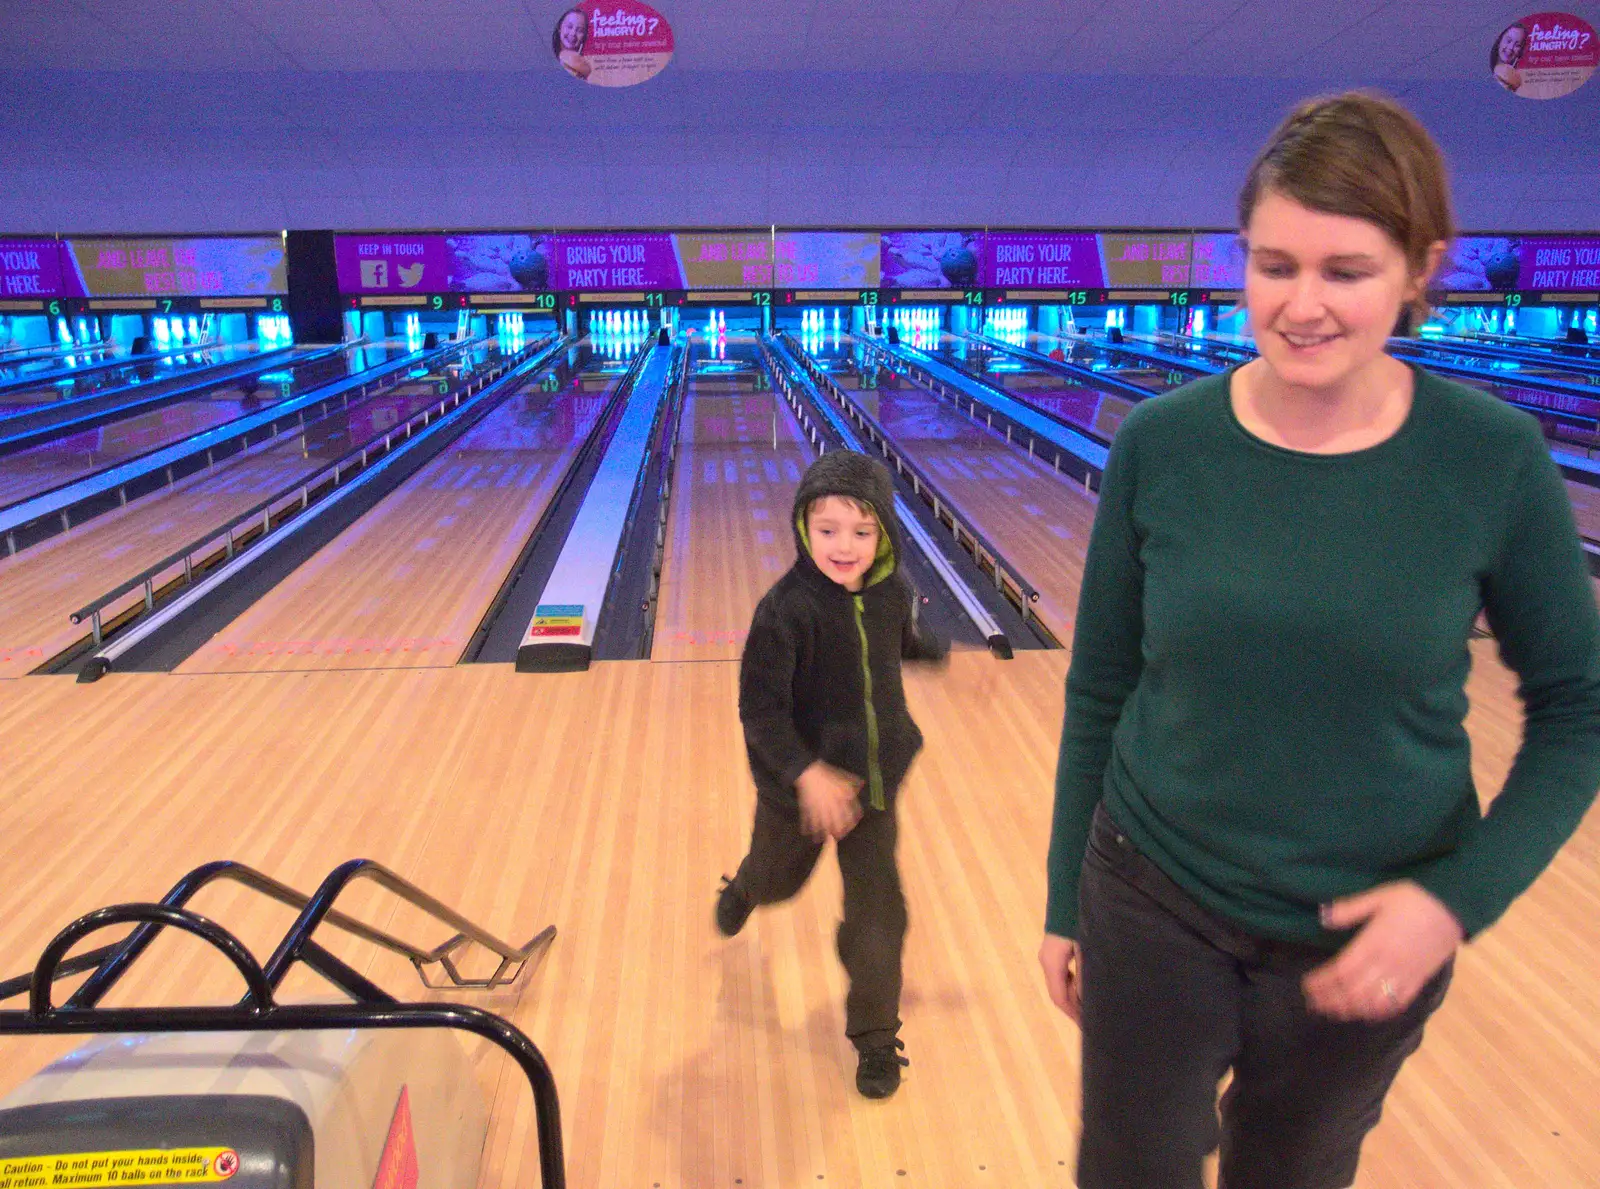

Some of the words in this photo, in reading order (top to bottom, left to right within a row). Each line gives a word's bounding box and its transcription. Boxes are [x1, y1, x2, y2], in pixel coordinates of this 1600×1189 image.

[591, 8, 646, 36] feeling
[1528, 24, 1580, 50] feeling
[358, 244, 380, 256] KEEP
[382, 244, 392, 256] IN
[394, 244, 424, 256] TOUCH
[567, 246, 607, 264] BRING
[608, 245, 644, 263] YOUR
[731, 242, 768, 260] LEAVE
[996, 244, 1034, 262] BRING
[1038, 244, 1071, 262] YOUR
[1152, 242, 1188, 260] LEAVE
[1536, 248, 1571, 266] BRING
[0, 251, 40, 270] YOUR
[568, 268, 608, 287] PARTY
[743, 265, 773, 284] REST
[778, 264, 794, 282] TO
[996, 267, 1034, 284] PARTY
[1162, 264, 1190, 282] REST
[1195, 264, 1209, 281] TO
[1532, 270, 1570, 288] PARTY
[272, 298, 282, 312] 8
[432, 296, 442, 310] 9
[536, 294, 555, 308] 10
[646, 294, 664, 308] 11
[752, 292, 771, 306] 12
[860, 292, 878, 304] 13
[964, 292, 982, 304] 14
[1069, 292, 1086, 304] 15
[1170, 292, 1188, 304] 16
[1505, 294, 1522, 306] 19
[50, 300, 60, 315] 6
[162, 300, 172, 314] 7
[4, 1162, 43, 1175] Caution
[55, 1160, 68, 1170] Do
[72, 1159, 88, 1169] not
[91, 1158, 109, 1170] put
[112, 1157, 134, 1169] your
[138, 1156, 168, 1166] hands
[172, 1152, 202, 1164] inside
[52, 1174, 102, 1184] Maximum
[108, 1170, 118, 1181] 10
[122, 1169, 146, 1180] balls
[149, 1170, 162, 1179] on
[166, 1168, 182, 1178] the
[186, 1166, 208, 1177] rack
